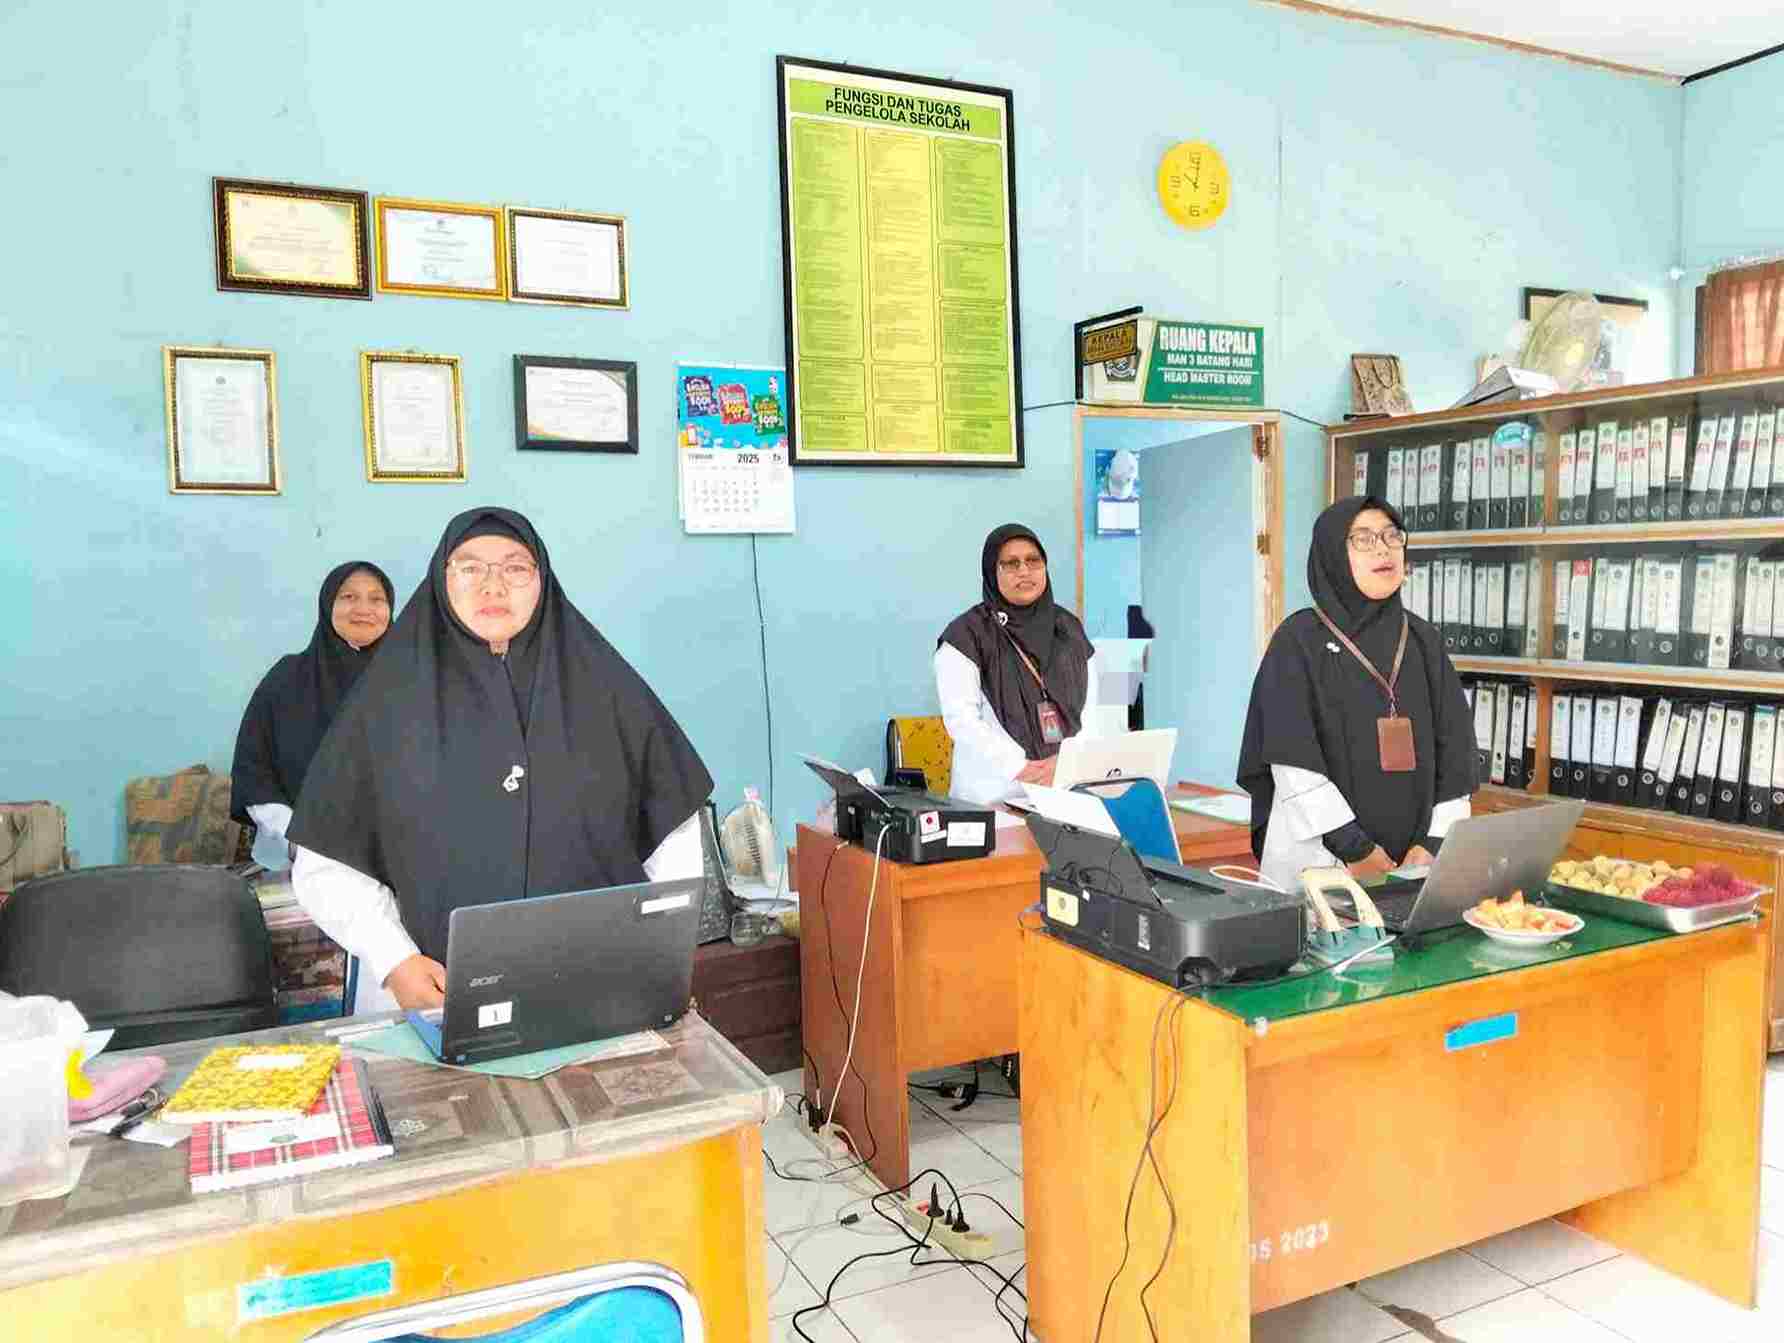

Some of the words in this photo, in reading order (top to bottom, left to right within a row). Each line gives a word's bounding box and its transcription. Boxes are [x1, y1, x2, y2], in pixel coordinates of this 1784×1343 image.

[834, 87, 883, 107] FUNGSI
[887, 95, 914, 111] DAN
[917, 99, 962, 118] TUGAS
[825, 99, 906, 123] PENGELOLA
[909, 111, 971, 131] SEKOLAH
[1159, 326, 1206, 352] RUANG
[1208, 329, 1257, 356] KEPALA
[1167, 353, 1188, 366] MAN
[1196, 355, 1231, 368] BATANG
[1232, 357, 1254, 369] HARI
[1163, 371, 1189, 384] HEAD
[1190, 373, 1226, 385] MASTER
[736, 453, 760, 465] 2025
[469, 973, 505, 988] acer
